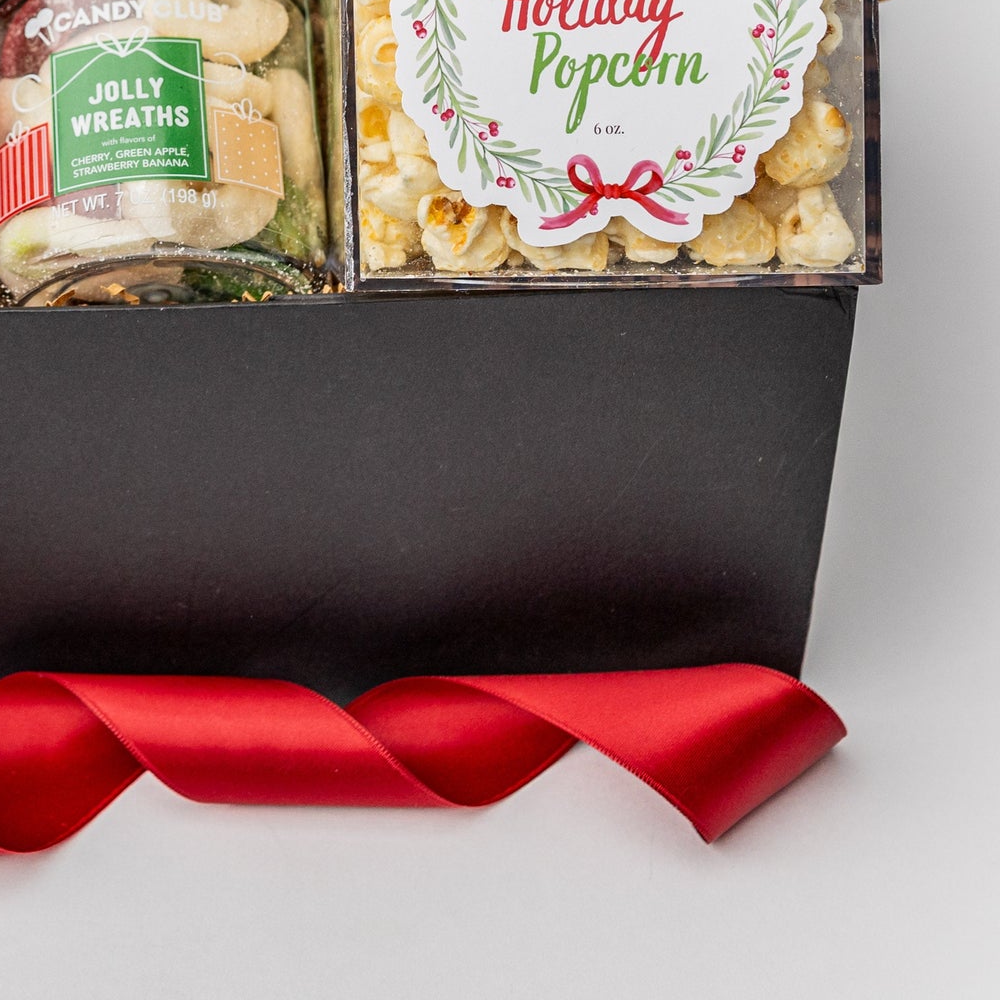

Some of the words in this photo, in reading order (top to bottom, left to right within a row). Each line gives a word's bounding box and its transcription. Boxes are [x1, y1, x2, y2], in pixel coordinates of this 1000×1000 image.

[53, 0, 145, 33] CANDY
[88, 77, 164, 105] JOLLY
[529, 31, 709, 134] Popcorn
[71, 105, 190, 137] WREATHS
[593, 122, 602, 135] 6
[605, 123, 625, 135] oz.
[101, 138, 118, 148] with
[119, 135, 146, 146] flavors
[147, 134, 157, 143] of
[71, 153, 113, 168] CHERRY,
[115, 148, 152, 160] GREEN
[154, 147, 191, 158] APPLE,
[72, 159, 139, 178] STRAWBERRY
[142, 158, 189, 168] BANANA
[51, 199, 79, 218] NET
[82, 192, 110, 211] WT.
[115, 191, 125, 207] 7
[161, 188, 198, 206] (198
[202, 191, 217, 209] g)
